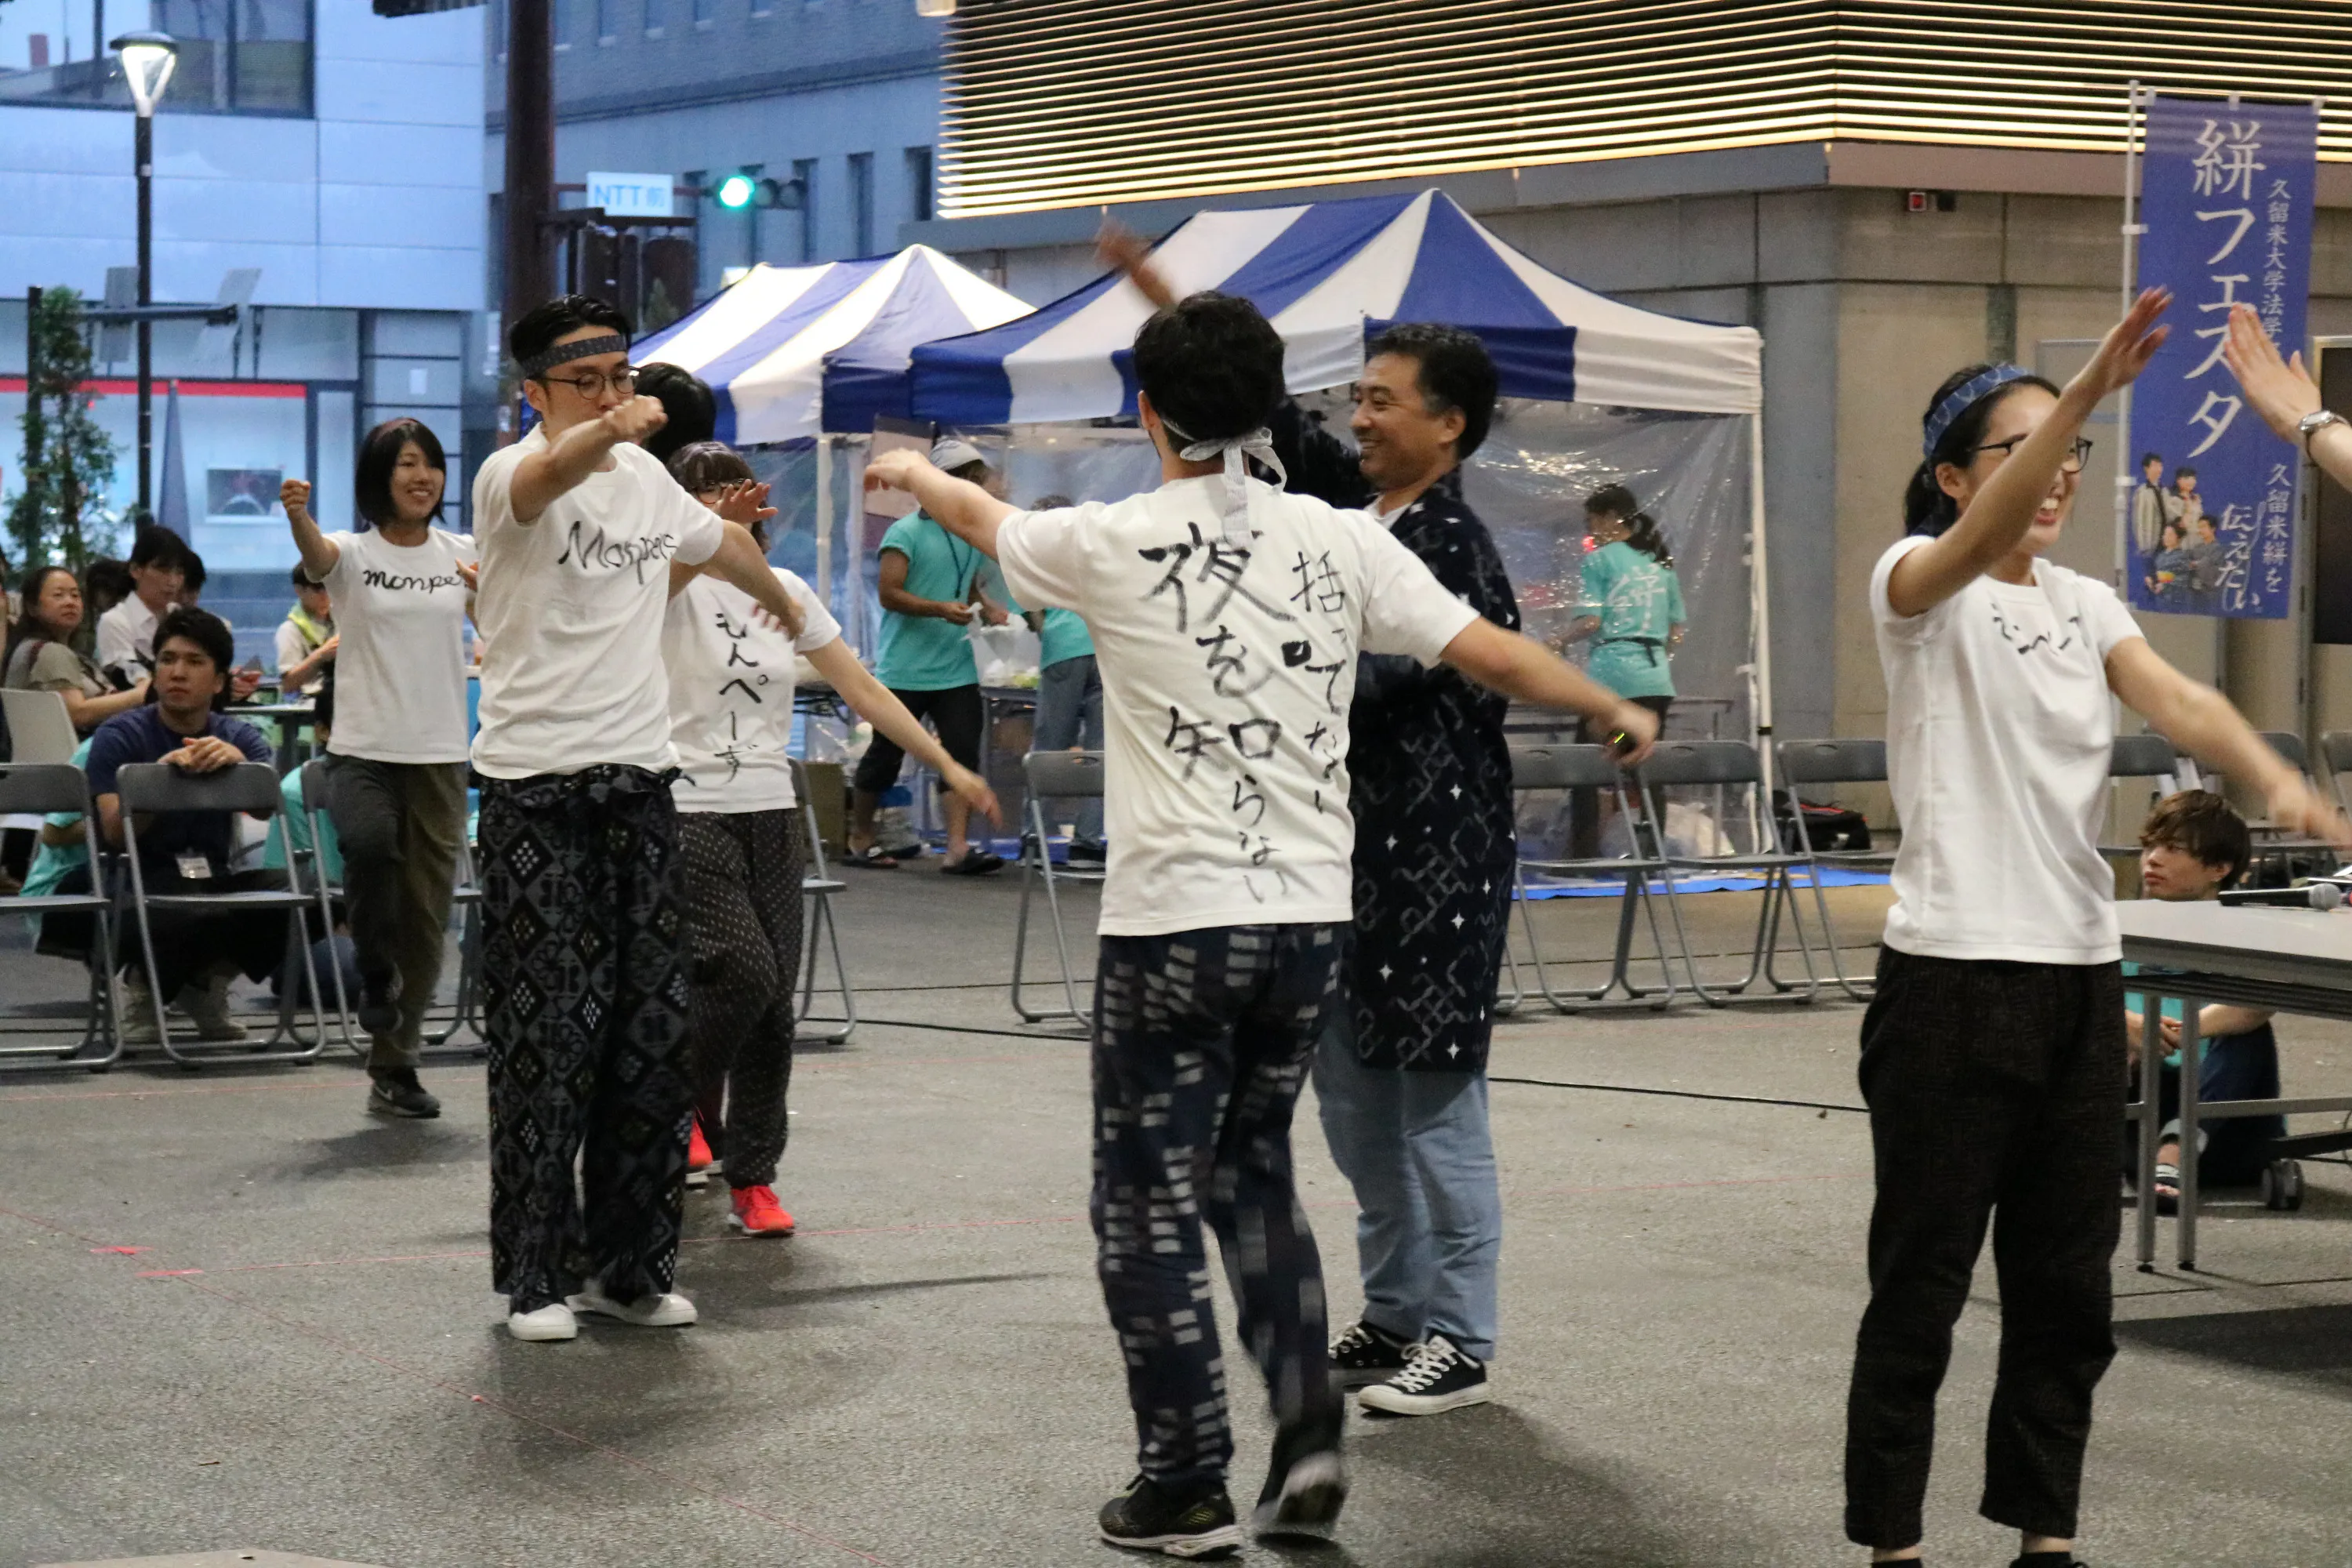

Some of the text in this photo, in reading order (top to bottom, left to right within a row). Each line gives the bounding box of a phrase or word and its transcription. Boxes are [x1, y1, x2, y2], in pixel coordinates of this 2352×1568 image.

[2183, 119, 2267, 459] 絣フェスタ
[2260, 178, 2292, 350] 久留米大学法学
[2214, 503, 2261, 610] 伝えたい
[713, 612, 770, 786] もんぺーず
